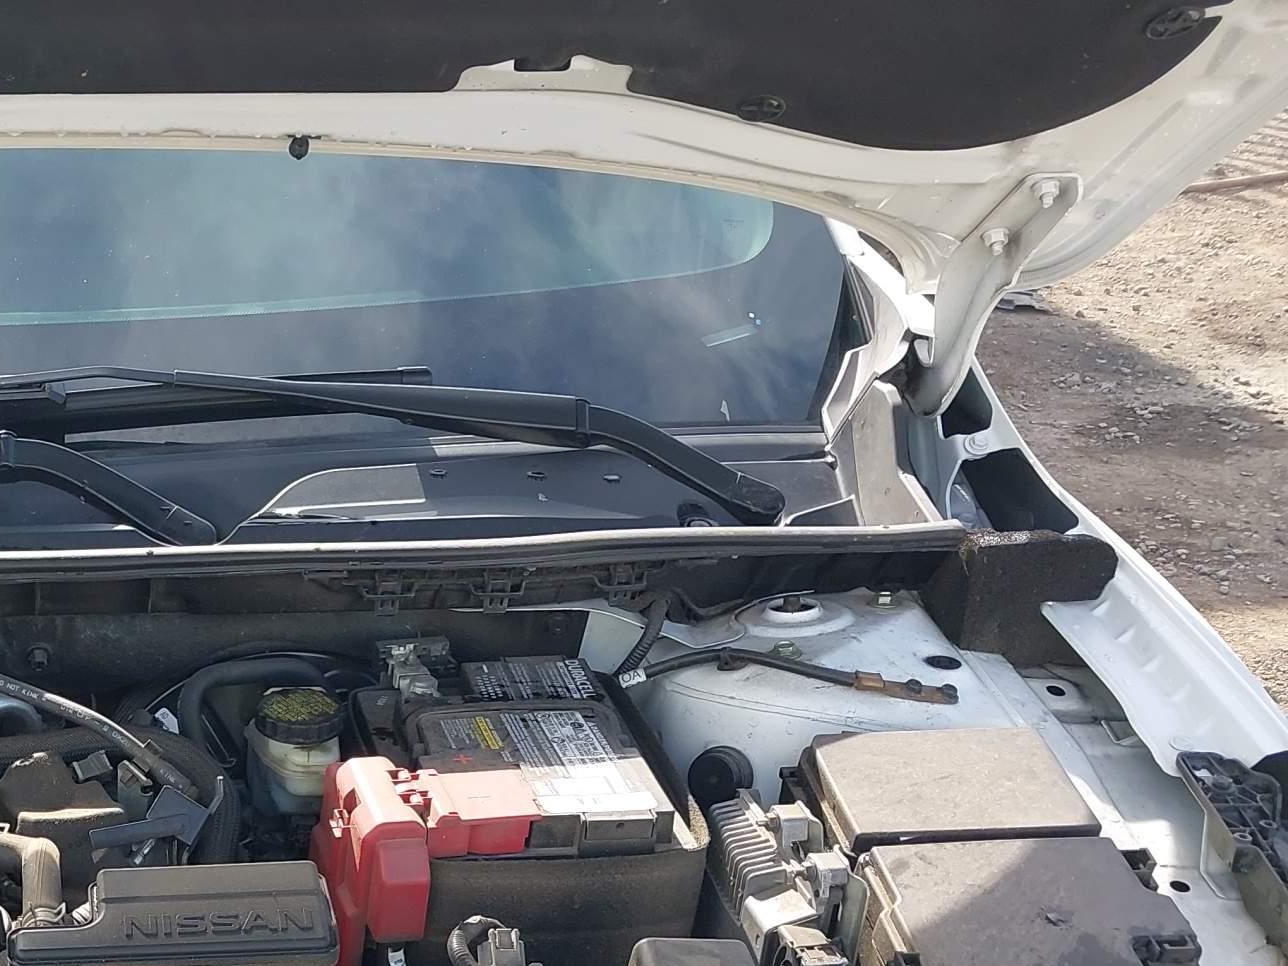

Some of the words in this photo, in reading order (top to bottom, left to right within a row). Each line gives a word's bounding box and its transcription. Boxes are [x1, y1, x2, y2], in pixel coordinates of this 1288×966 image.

[6, 682, 20, 692] NOT
[564, 659, 597, 698] DURACELL
[122, 909, 315, 938] NISSAN
